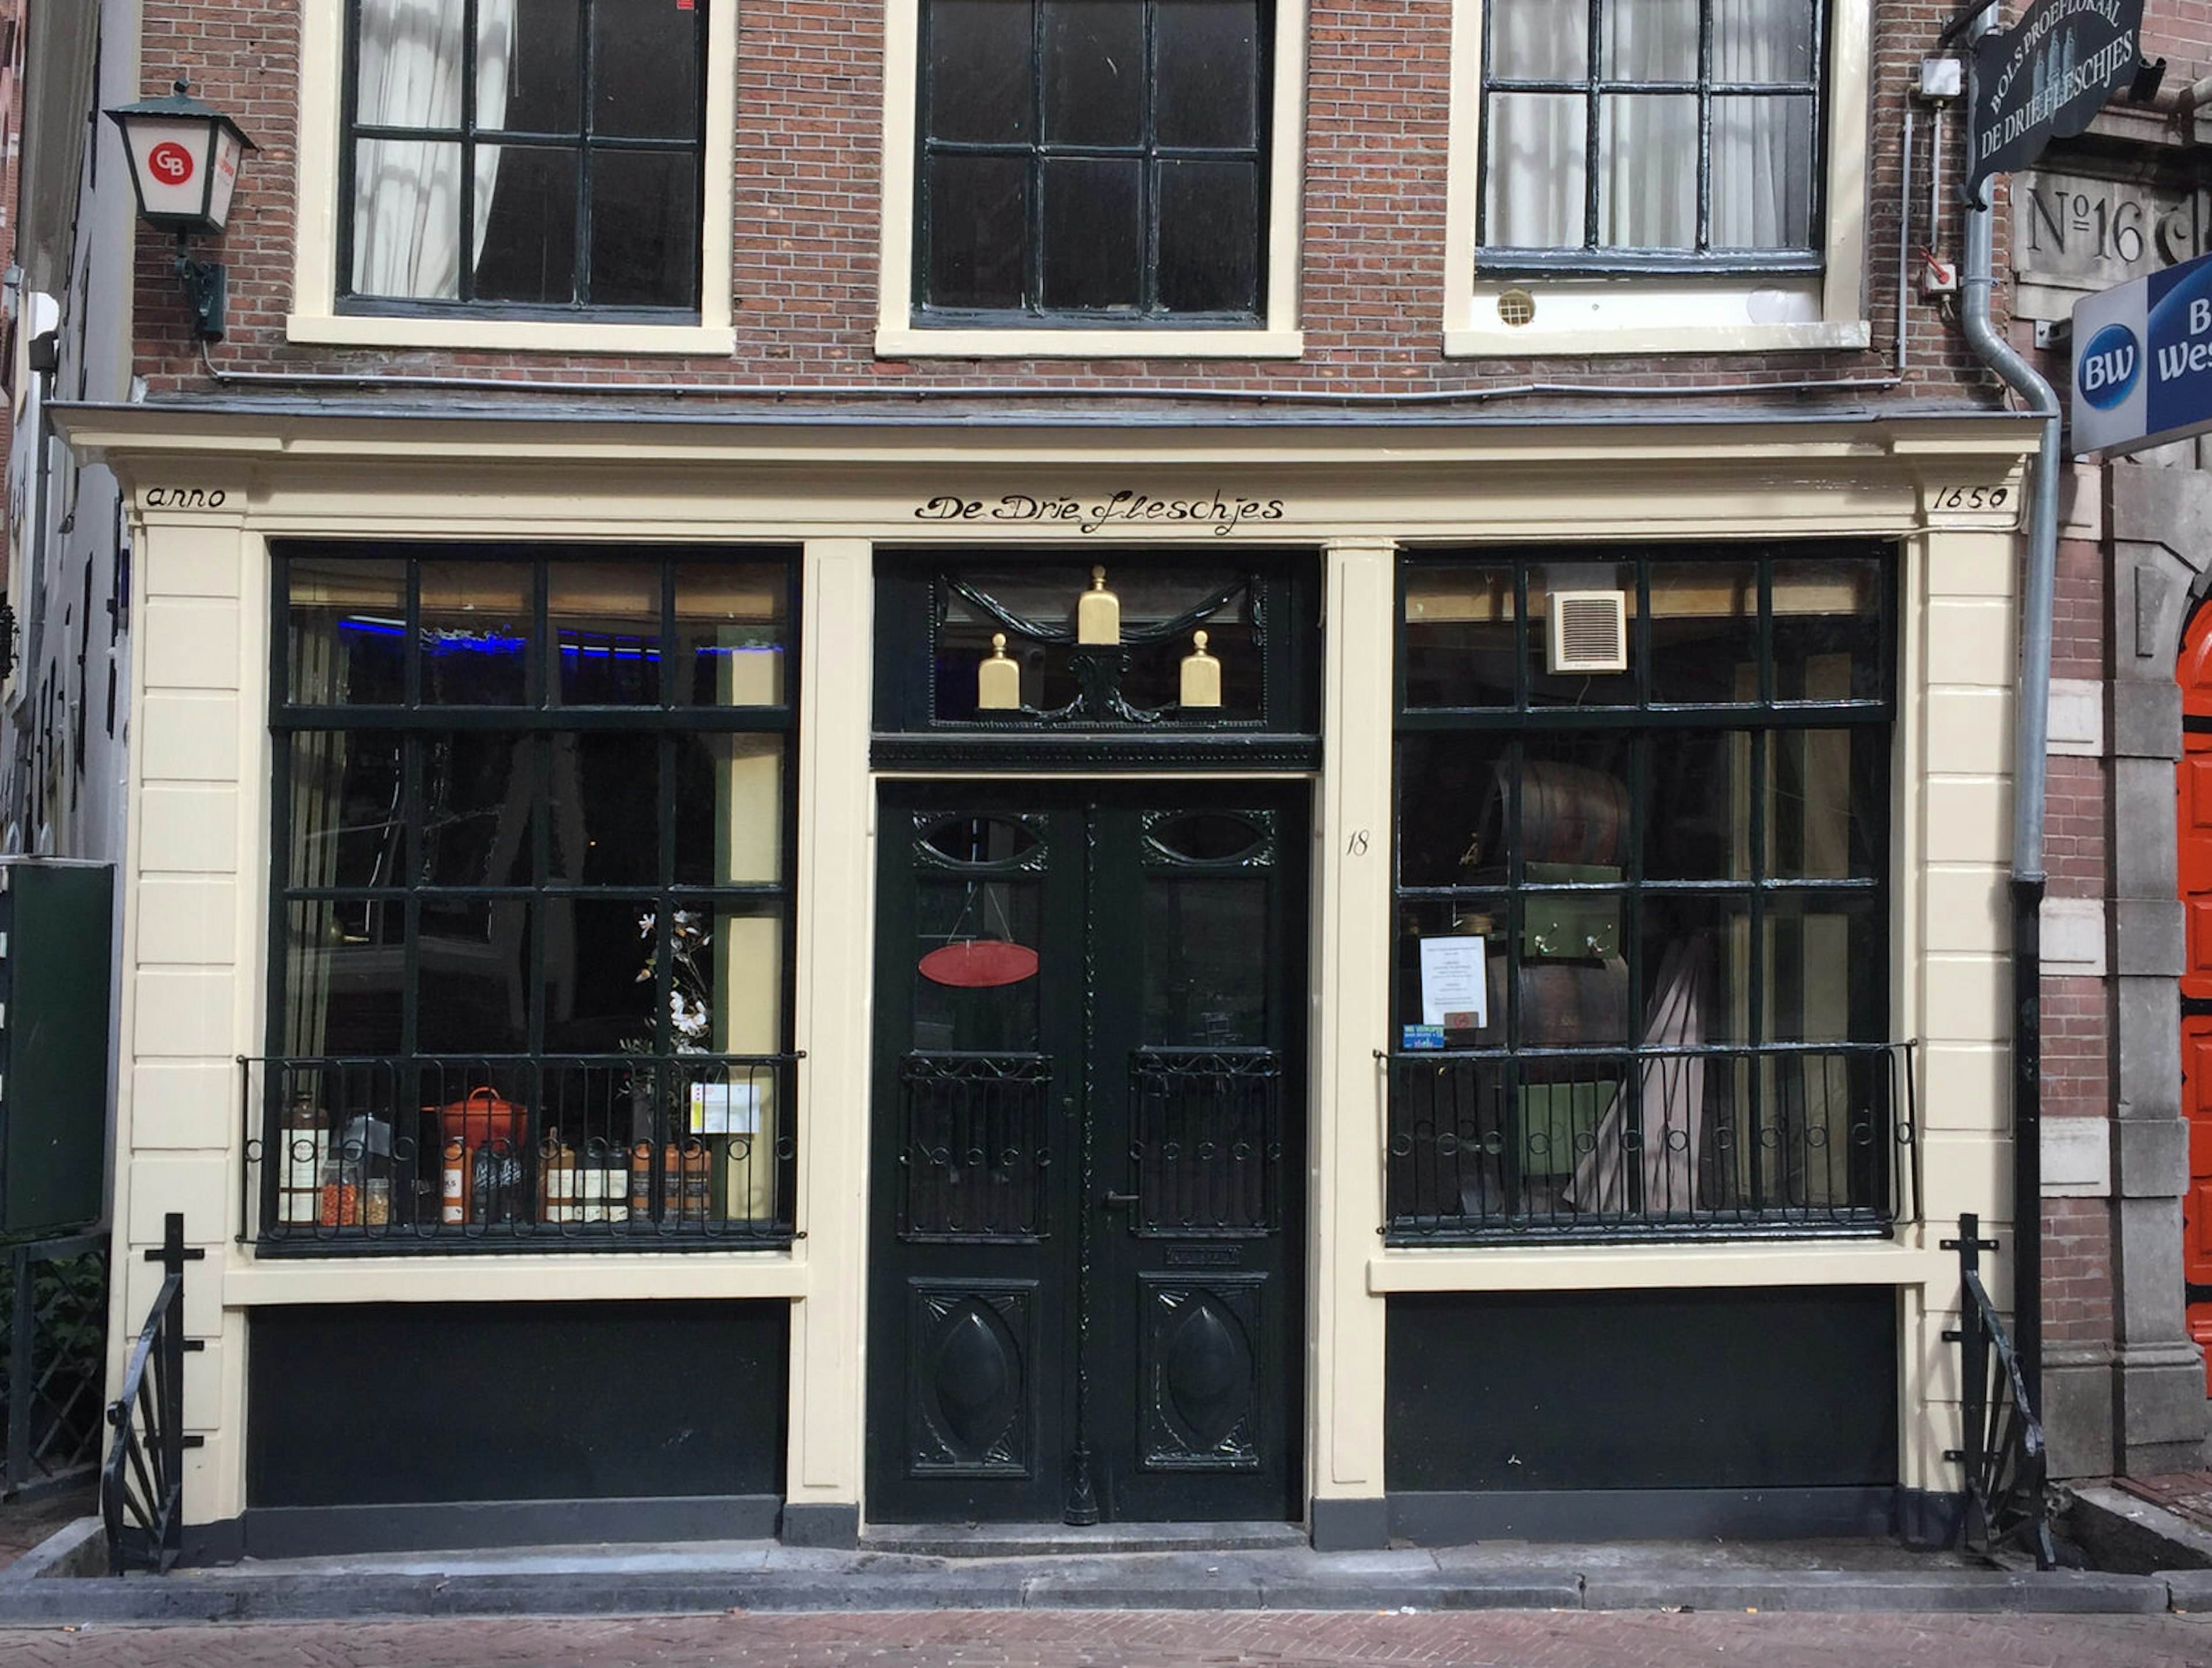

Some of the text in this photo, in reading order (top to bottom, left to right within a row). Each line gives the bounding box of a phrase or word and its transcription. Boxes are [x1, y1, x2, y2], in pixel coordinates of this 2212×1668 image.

[1990, 47, 2024, 115] BOLS
[1982, 123, 2002, 160] DE
[156, 150, 185, 176] GB
[2085, 344, 2134, 392] BW
[146, 487, 226, 507] anno
[915, 496, 984, 519] De
[991, 495, 1082, 522] Drie
[1934, 486, 2008, 509] 1650
[1346, 829, 1370, 857] 18
